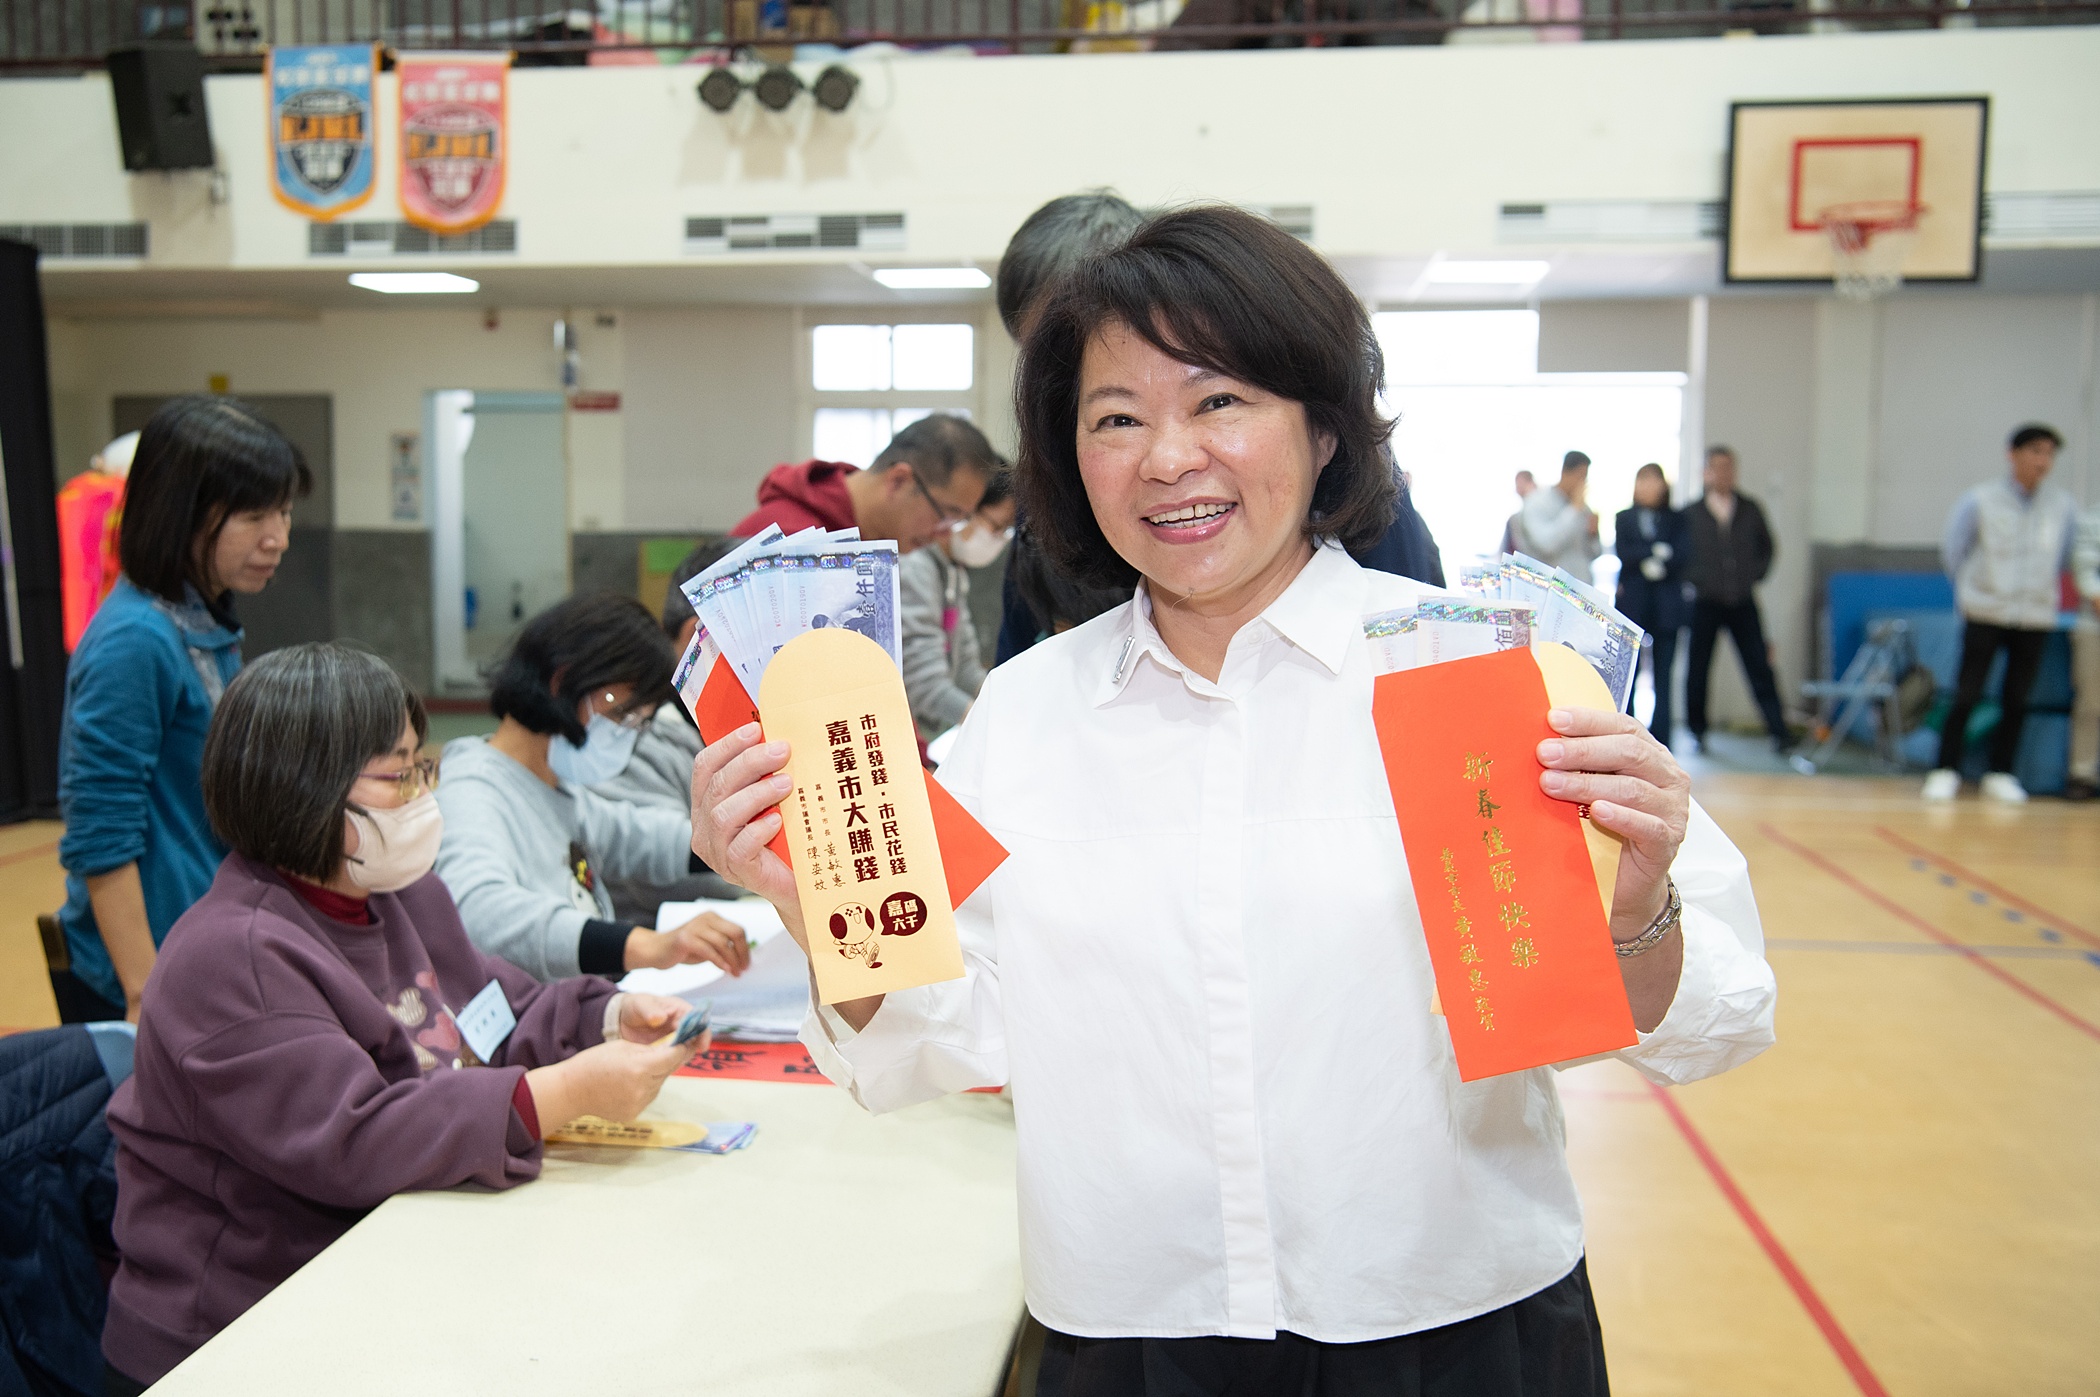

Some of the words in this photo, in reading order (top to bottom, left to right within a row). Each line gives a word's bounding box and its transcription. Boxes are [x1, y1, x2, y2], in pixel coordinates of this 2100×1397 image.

[1494, 610, 1512, 652] 佰圓
[825, 719, 880, 883] 嘉義市大賺錢
[1462, 751, 1539, 969] 新春佳節快樂
[892, 914, 918, 931] 六千
